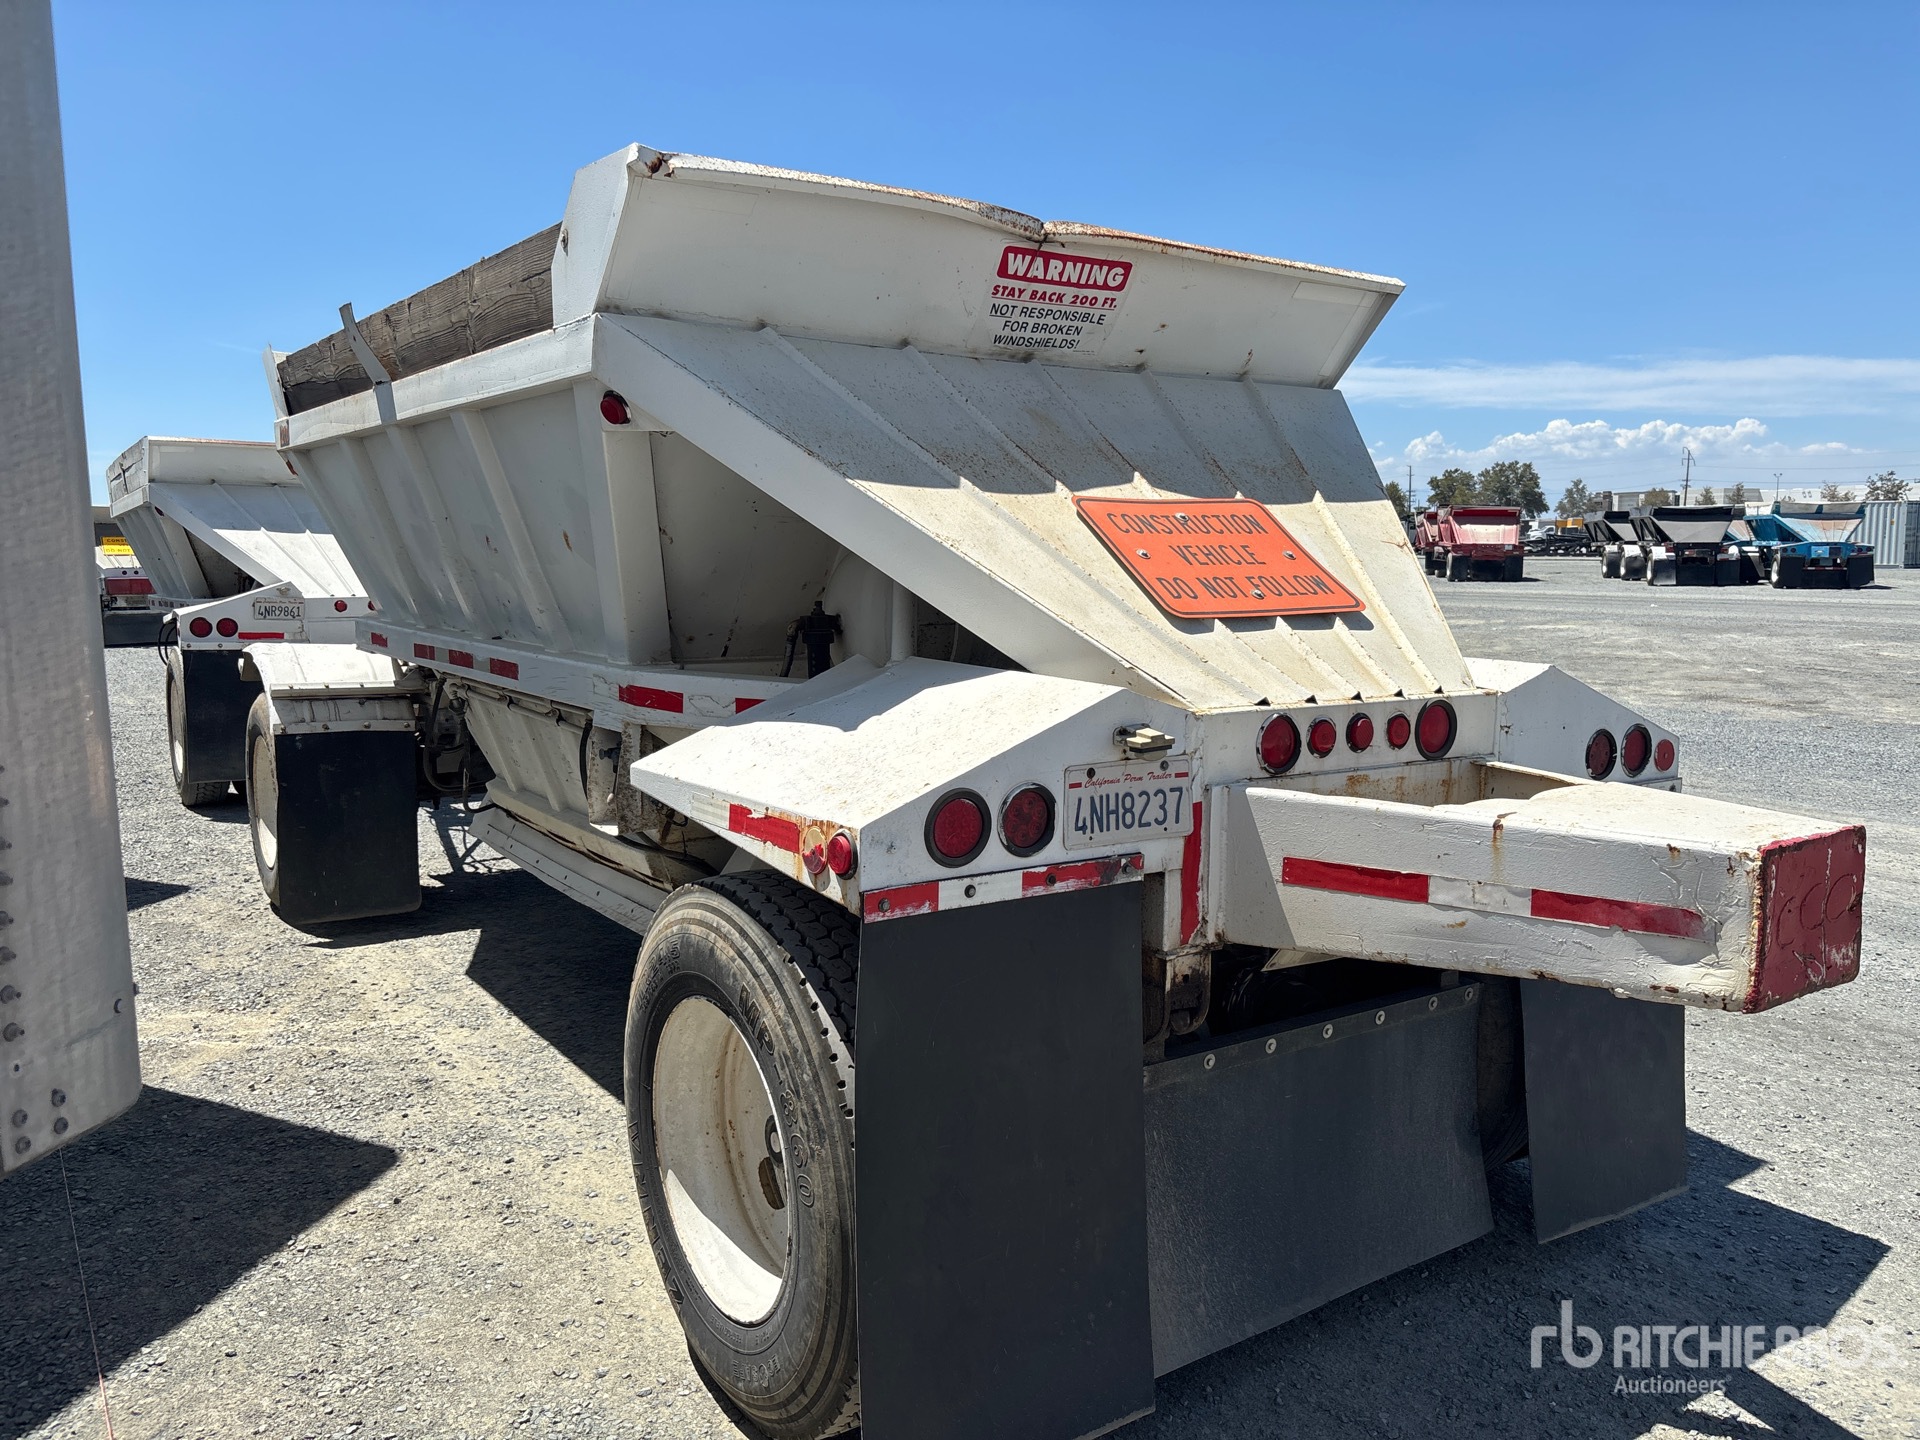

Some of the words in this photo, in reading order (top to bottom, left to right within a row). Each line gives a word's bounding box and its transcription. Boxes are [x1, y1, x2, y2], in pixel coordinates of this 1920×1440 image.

[1007, 252, 1125, 288] WARNING
[991, 284, 1027, 298] STAY
[1029, 289, 1067, 304] BACK
[1069, 294, 1099, 307] 200
[1101, 297, 1117, 308] FT.
[990, 303, 1018, 317] NOT
[1019, 306, 1106, 325] RESPONSIBLE
[1002, 320, 1029, 333] FOR
[1030, 322, 1083, 336] BROKEN
[993, 334, 1080, 349] WINDSHIELDS!
[1106, 512, 1269, 535] CONSTRUCTION
[1168, 544, 1266, 566] VEHICLE
[1156, 576, 1199, 600] DO
[1197, 575, 1249, 599] NOT
[1245, 575, 1335, 598] FOLLOW
[257, 605, 301, 617] 4NR9861
[1084, 778, 1120, 789] California
[1123, 773, 1144, 783] Perm
[1147, 771, 1172, 781] Trailer
[1074, 786, 1183, 835] 4NH8237
